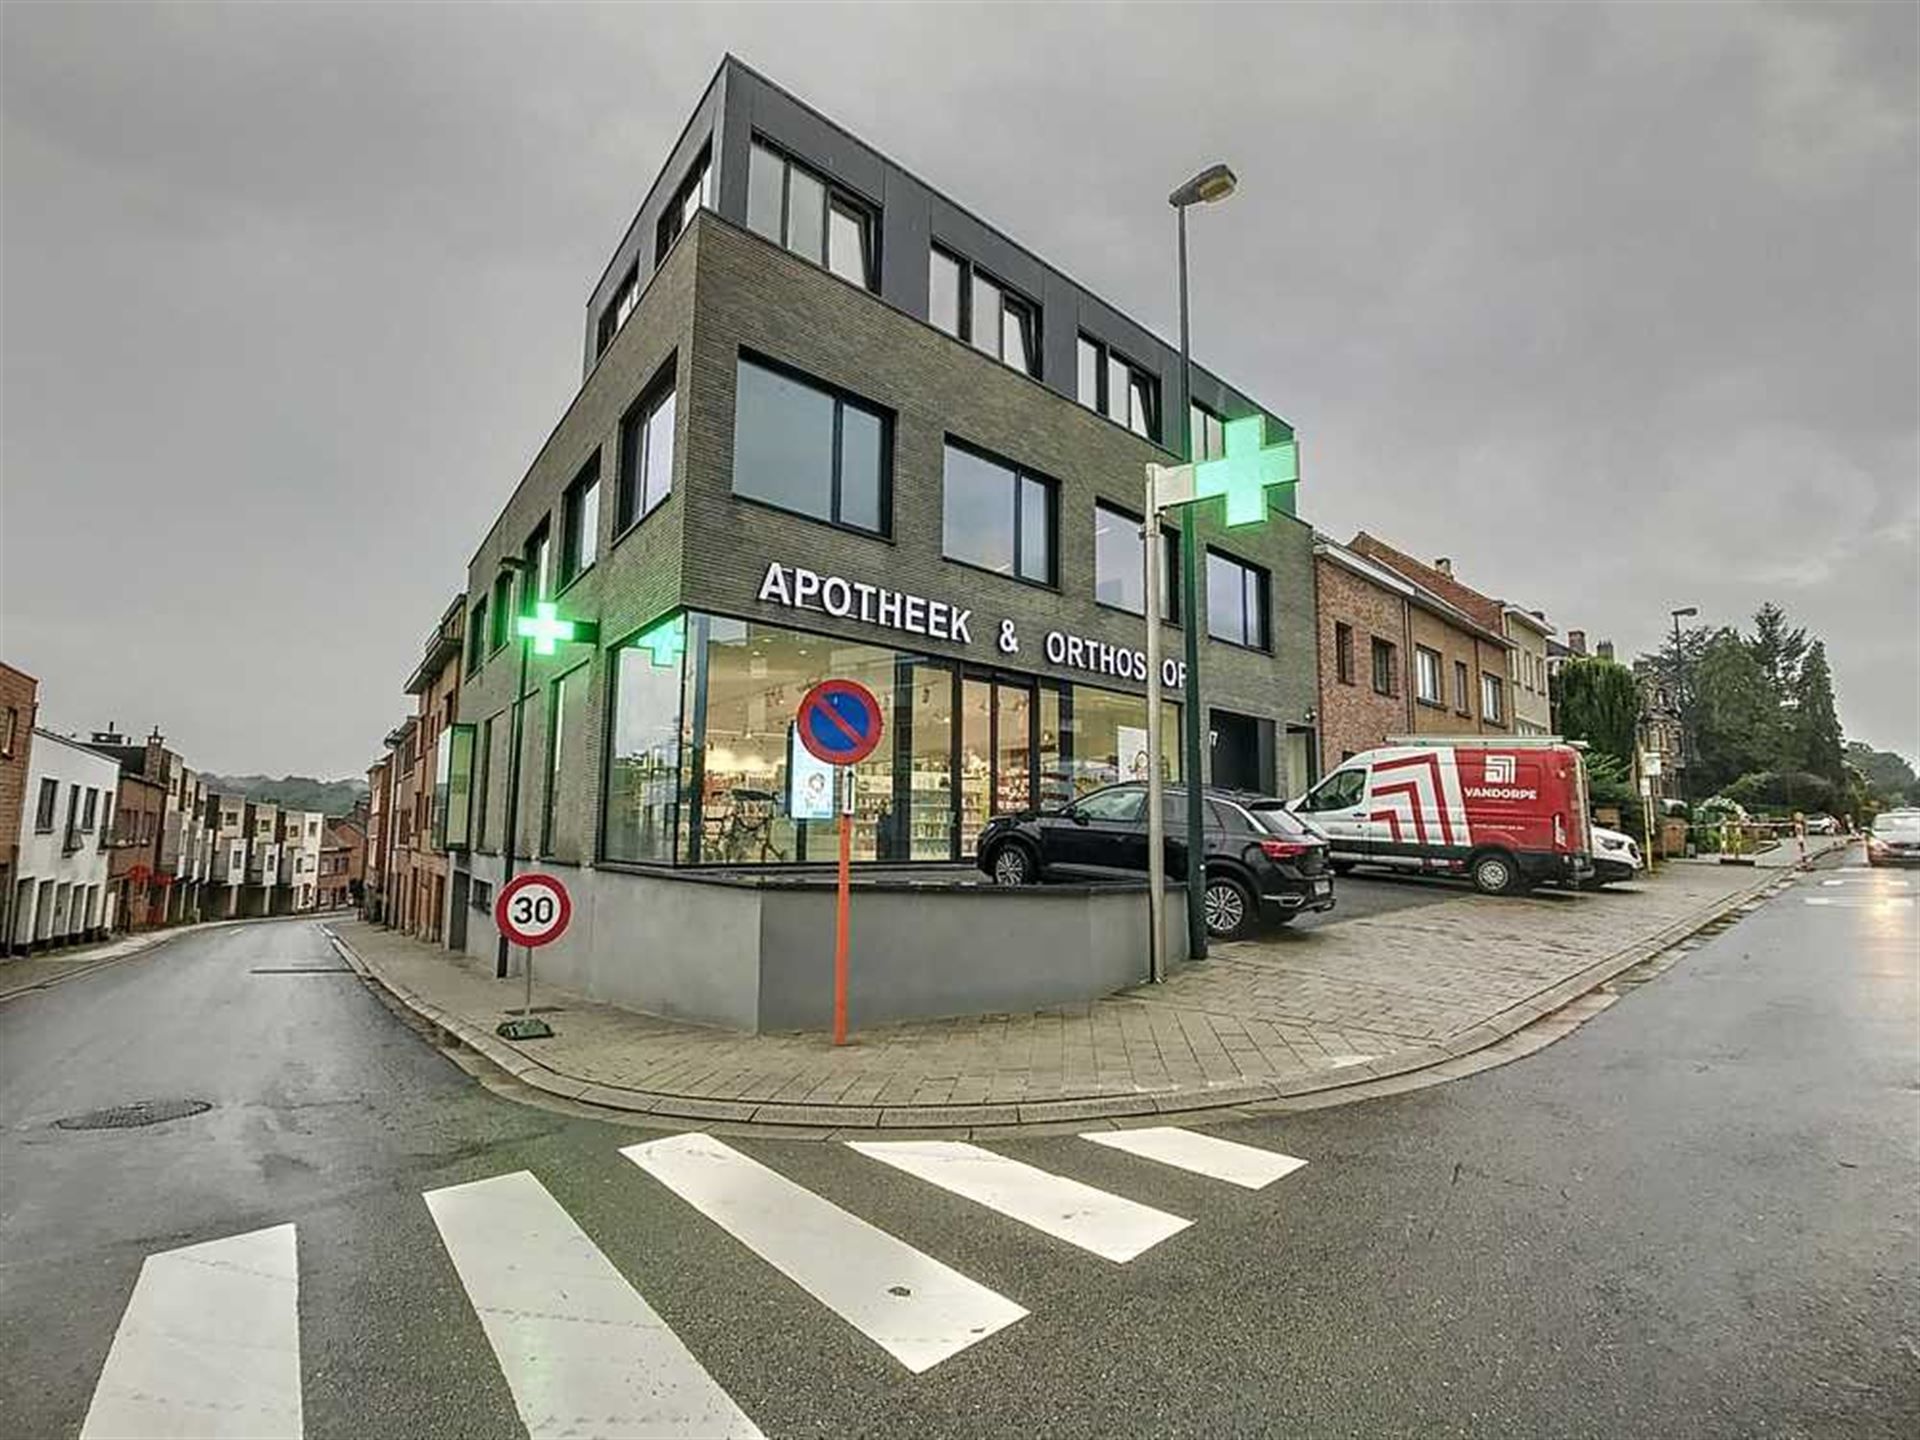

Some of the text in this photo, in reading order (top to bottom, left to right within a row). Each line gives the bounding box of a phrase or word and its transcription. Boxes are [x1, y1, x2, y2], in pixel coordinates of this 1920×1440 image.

[758, 562, 1186, 688] APOTHEEK & ORTHOSOP
[1463, 787, 1537, 800] VANDORPE
[514, 896, 553, 924] 30
